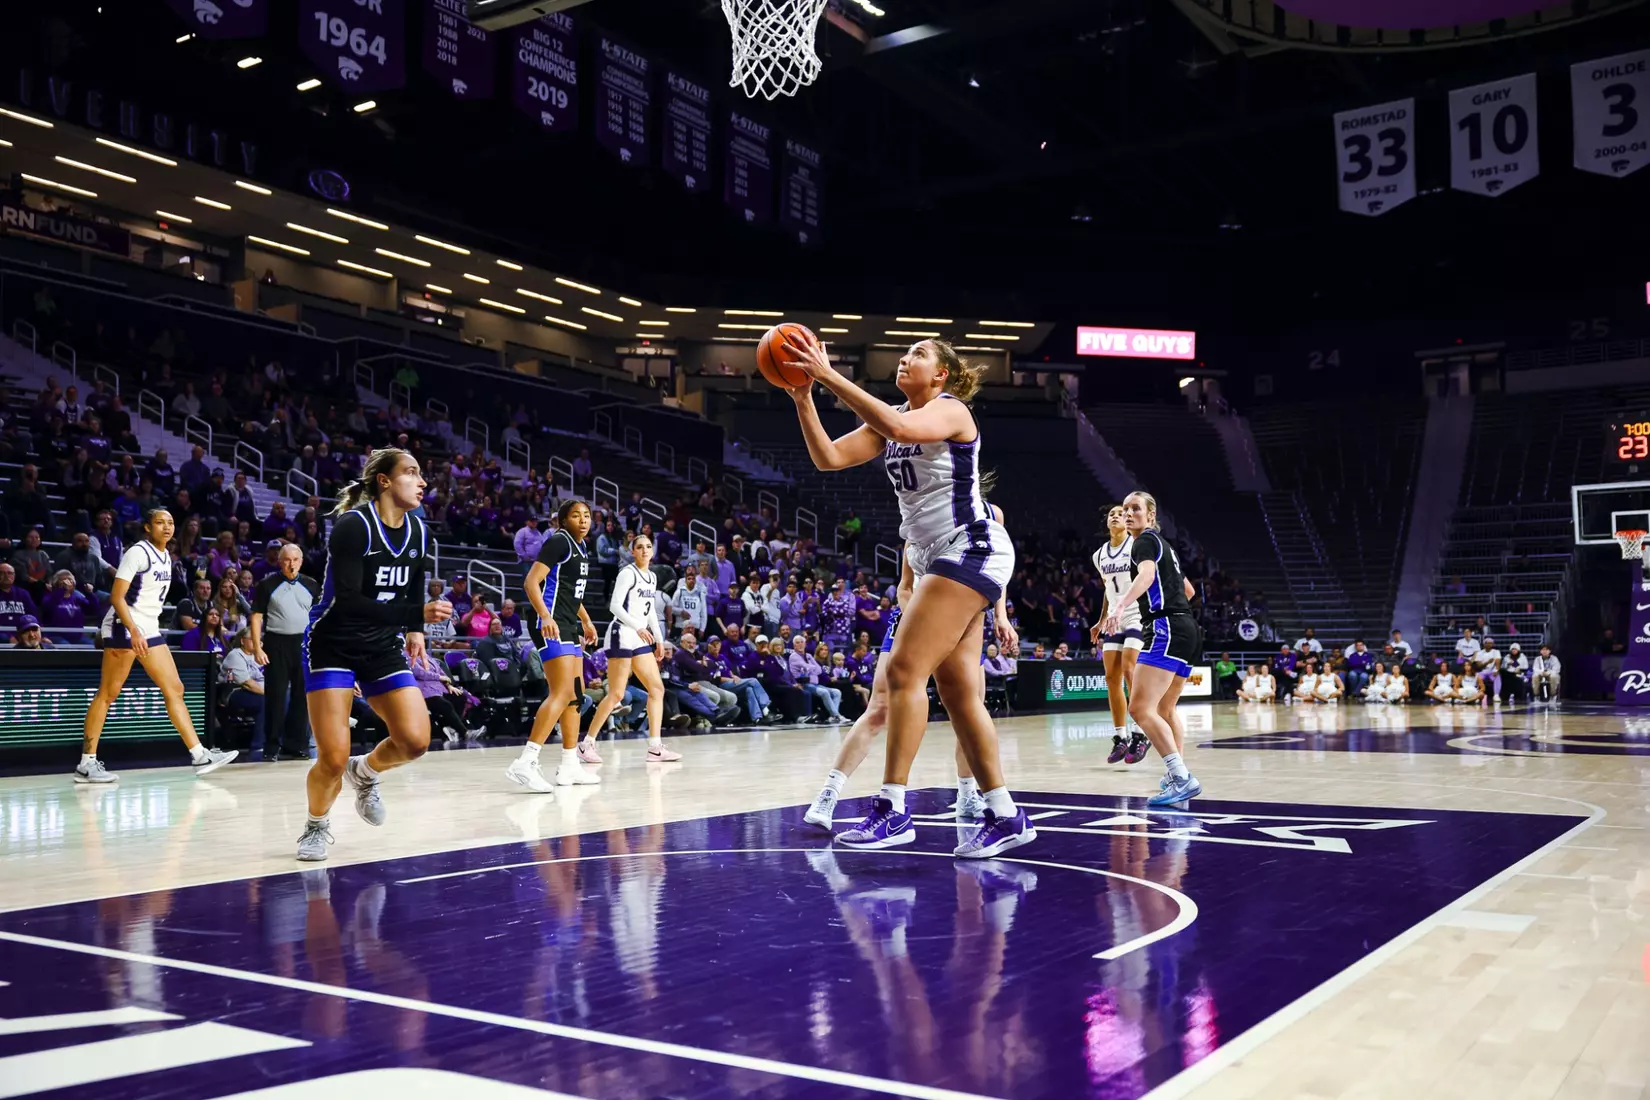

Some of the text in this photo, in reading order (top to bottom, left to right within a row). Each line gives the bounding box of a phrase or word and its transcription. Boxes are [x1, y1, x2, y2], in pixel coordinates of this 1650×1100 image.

[438, 12, 458, 28] 1981
[314, 11, 387, 66] 1964
[467, 25, 486, 41] 2023
[533, 28, 550, 46] BIG
[551, 38, 563, 53] 12
[436, 37, 458, 53] 2010
[519, 37, 577, 71] CONFERENCE
[601, 38, 649, 71] K-STATE
[436, 50, 457, 66] 2018
[518, 49, 577, 85] CHAMPIONS
[1591, 60, 1646, 81] OHLDE
[527, 76, 569, 109] 2019
[668, 71, 711, 102] K-STATE
[1472, 88, 1512, 106] GARY
[1341, 109, 1407, 131] ROMSTAD
[1602, 83, 1638, 137] 3
[731, 111, 770, 140] K-STATE
[1458, 104, 1529, 161] 10
[786, 138, 821, 165] K-STATE
[1342, 127, 1408, 183] 33
[1594, 142, 1648, 158] 2000-04
[1471, 162, 1519, 179] 1981-83
[1354, 184, 1398, 199] 1979-82
[1569, 316, 1610, 340] 25
[1079, 332, 1192, 354] FIVE GUYS
[1308, 349, 1341, 371] 24
[1617, 436, 1649, 460] 23
[887, 459, 919, 492] 50
[375, 565, 410, 587] EIU
[1112, 576, 1120, 593] 1
[644, 601, 652, 616] 3
[684, 600, 698, 610] 50
[1066, 675, 1084, 691] OLD
